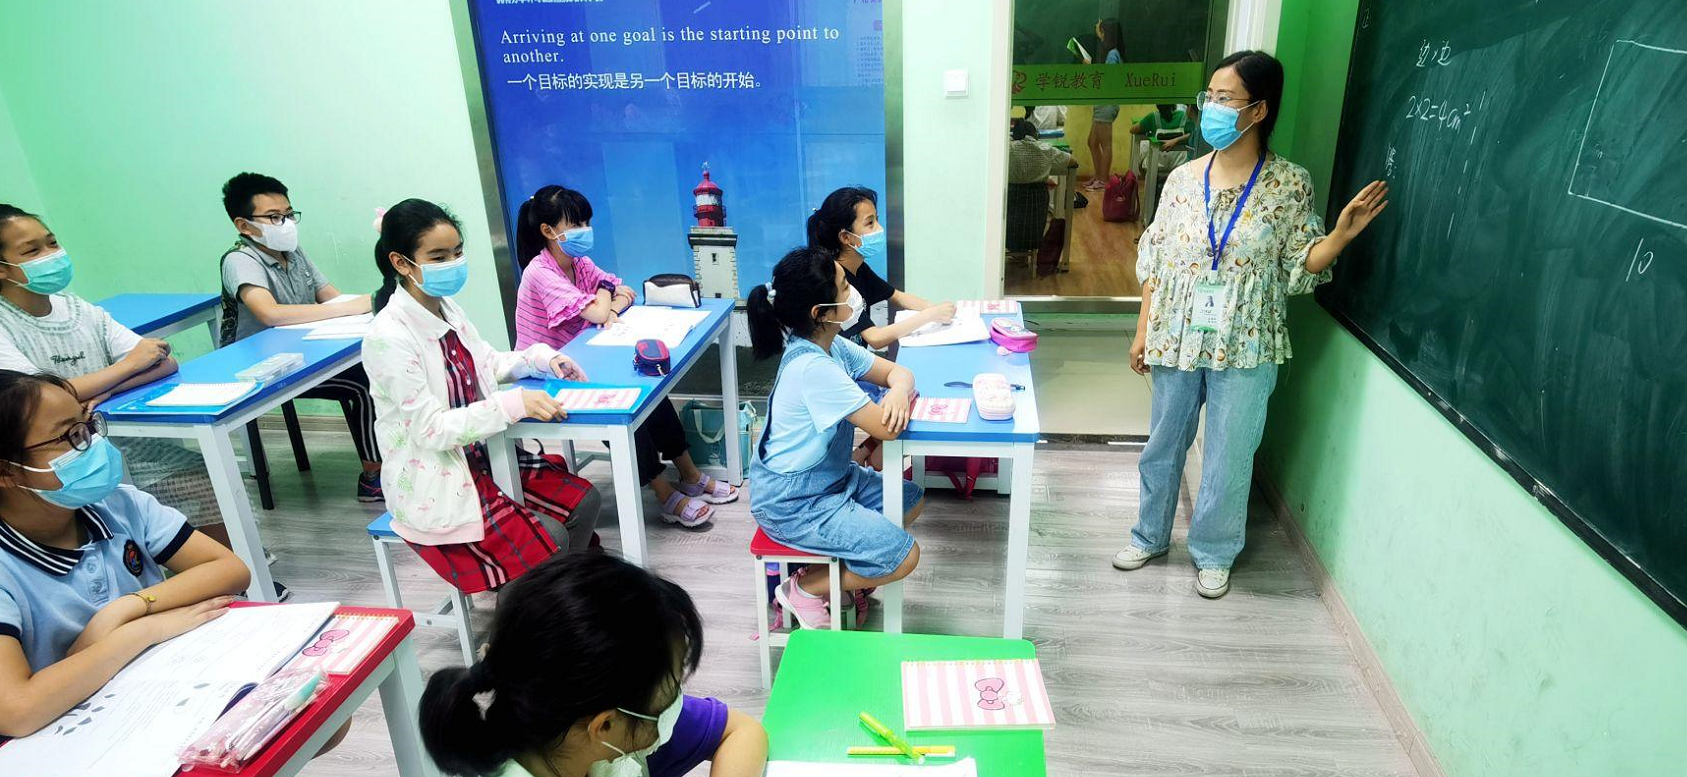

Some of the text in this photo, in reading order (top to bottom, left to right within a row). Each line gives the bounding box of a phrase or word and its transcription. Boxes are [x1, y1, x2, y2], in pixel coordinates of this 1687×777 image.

[500, 25, 840, 47] Arriving at one goal is the starting point to
[503, 48, 565, 64] another.
[506, 71, 761, 90] 一个目标的实现是另一个目标的开始。
[1035, 70, 1105, 92] 学锐教育
[1124, 72, 1177, 88] XueRui
